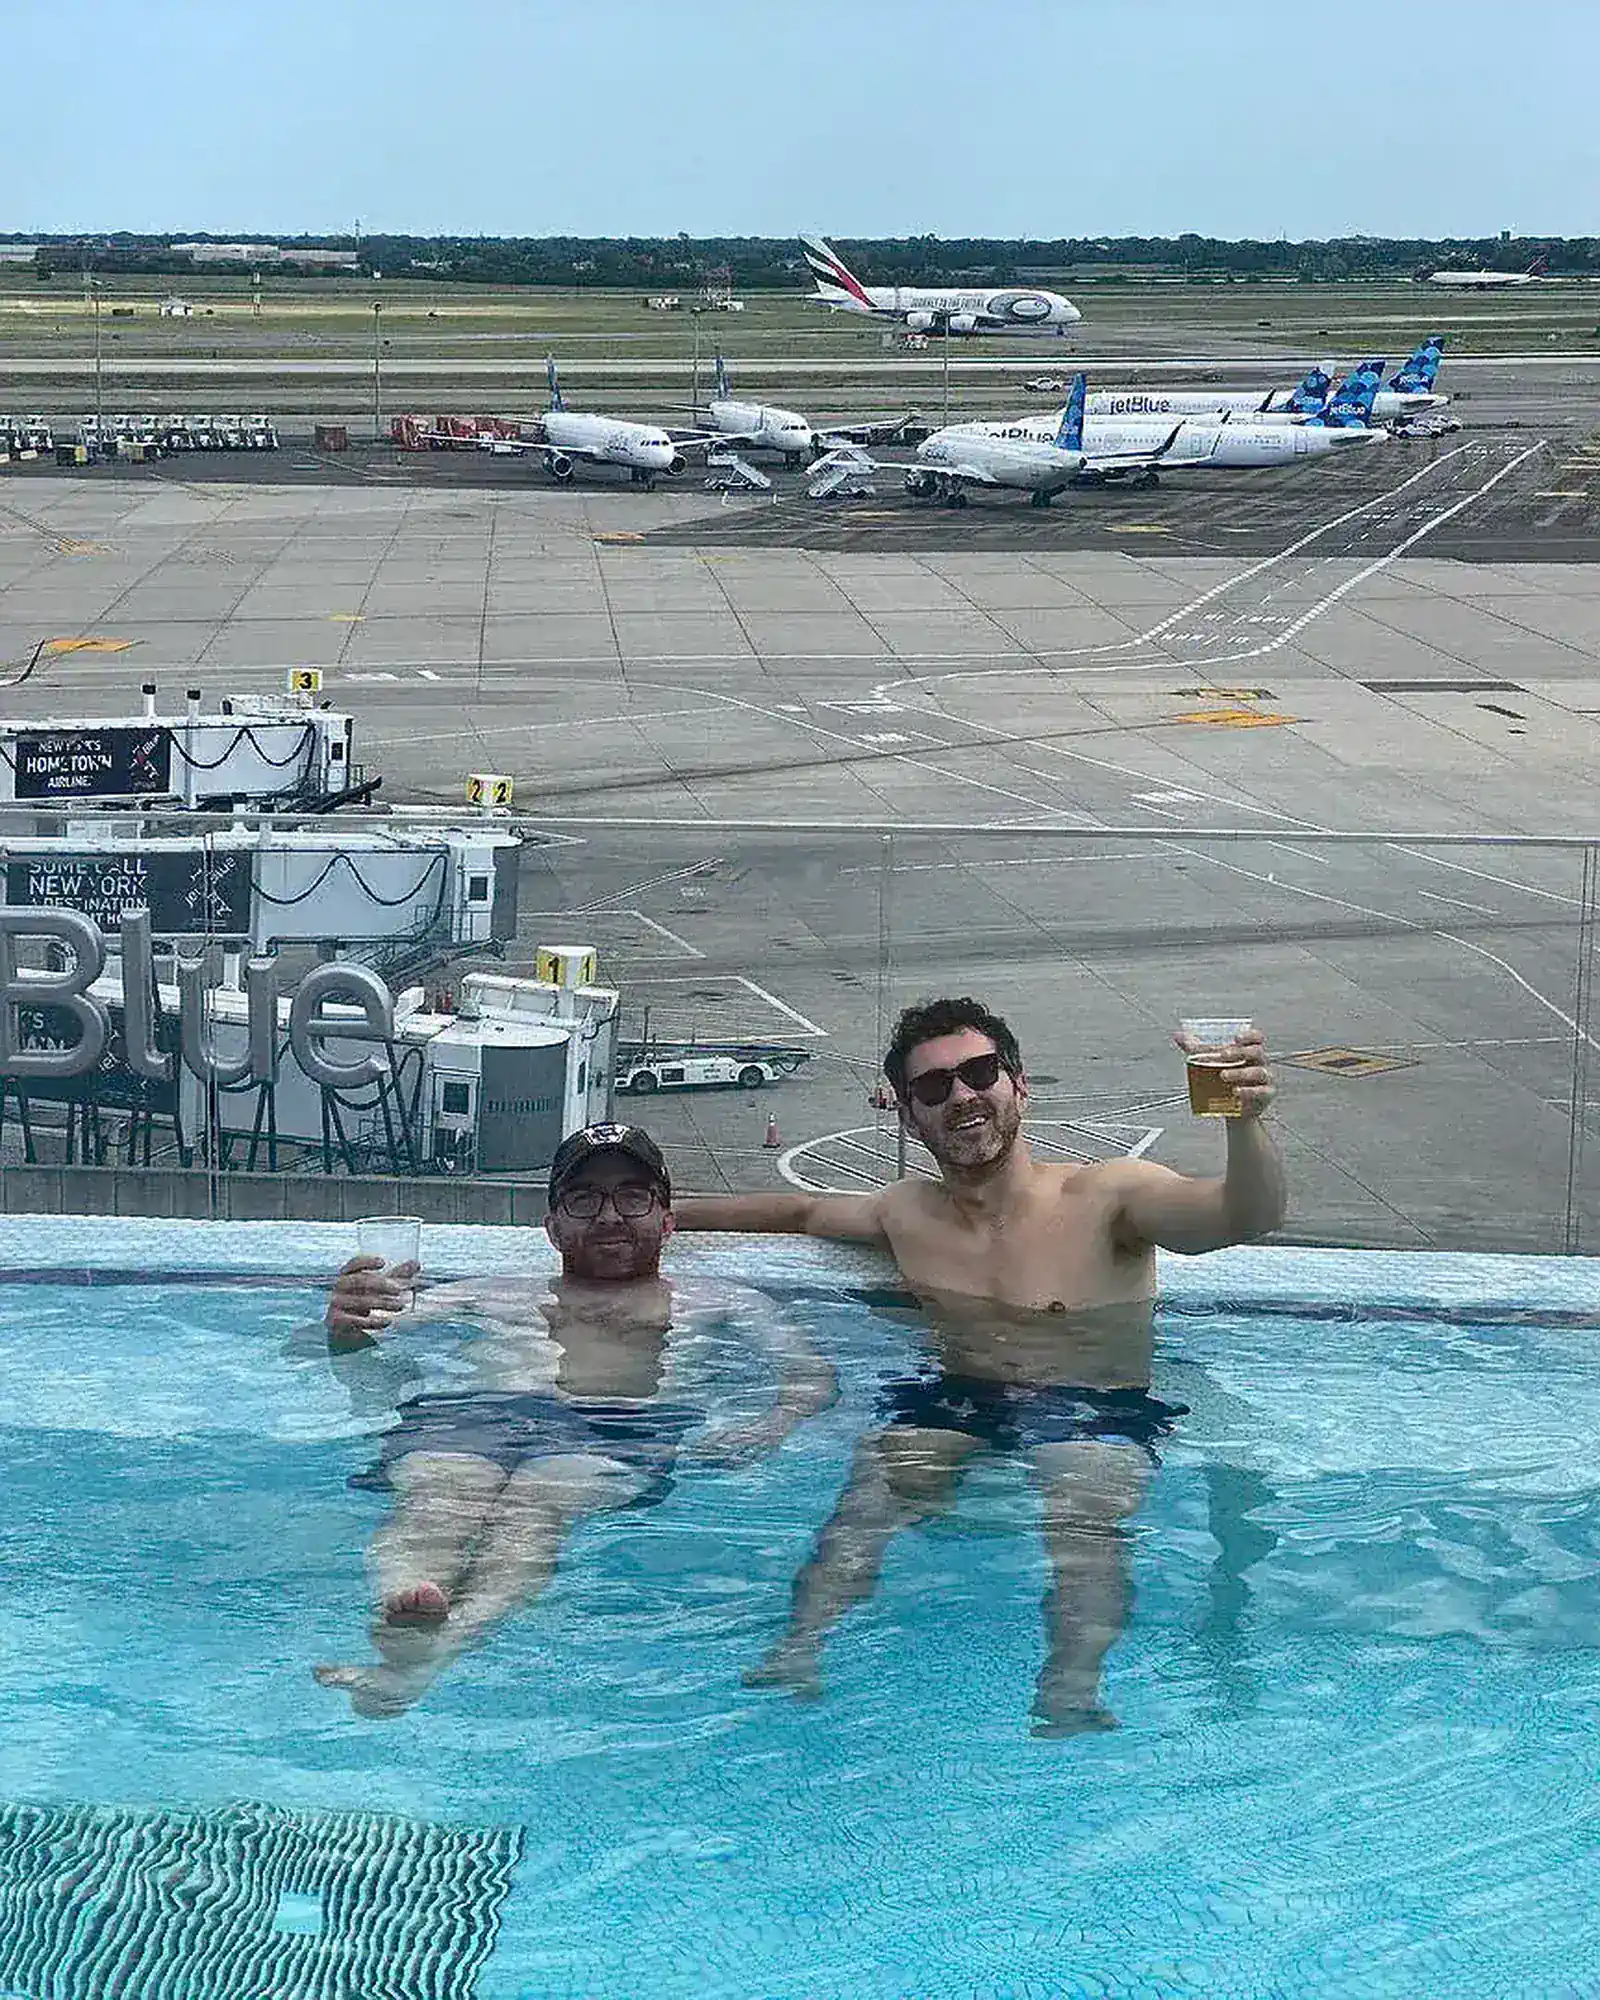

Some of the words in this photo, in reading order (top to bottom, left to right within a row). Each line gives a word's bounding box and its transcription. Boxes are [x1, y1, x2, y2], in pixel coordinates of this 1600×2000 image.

[1109, 396, 1170, 414] jetBlue
[301, 672, 312, 690] 3
[38, 741, 65, 753] NEW
[66, 740, 101, 751] YK'S
[26, 754, 112, 773] HOMETOWN
[471, 780, 481, 801] 2
[496, 782, 507, 802] 2
[29, 859, 87, 874] SOME
[29, 875, 81, 896] NEW
[548, 957, 560, 981] 1
[0, 905, 393, 1090] Blue
